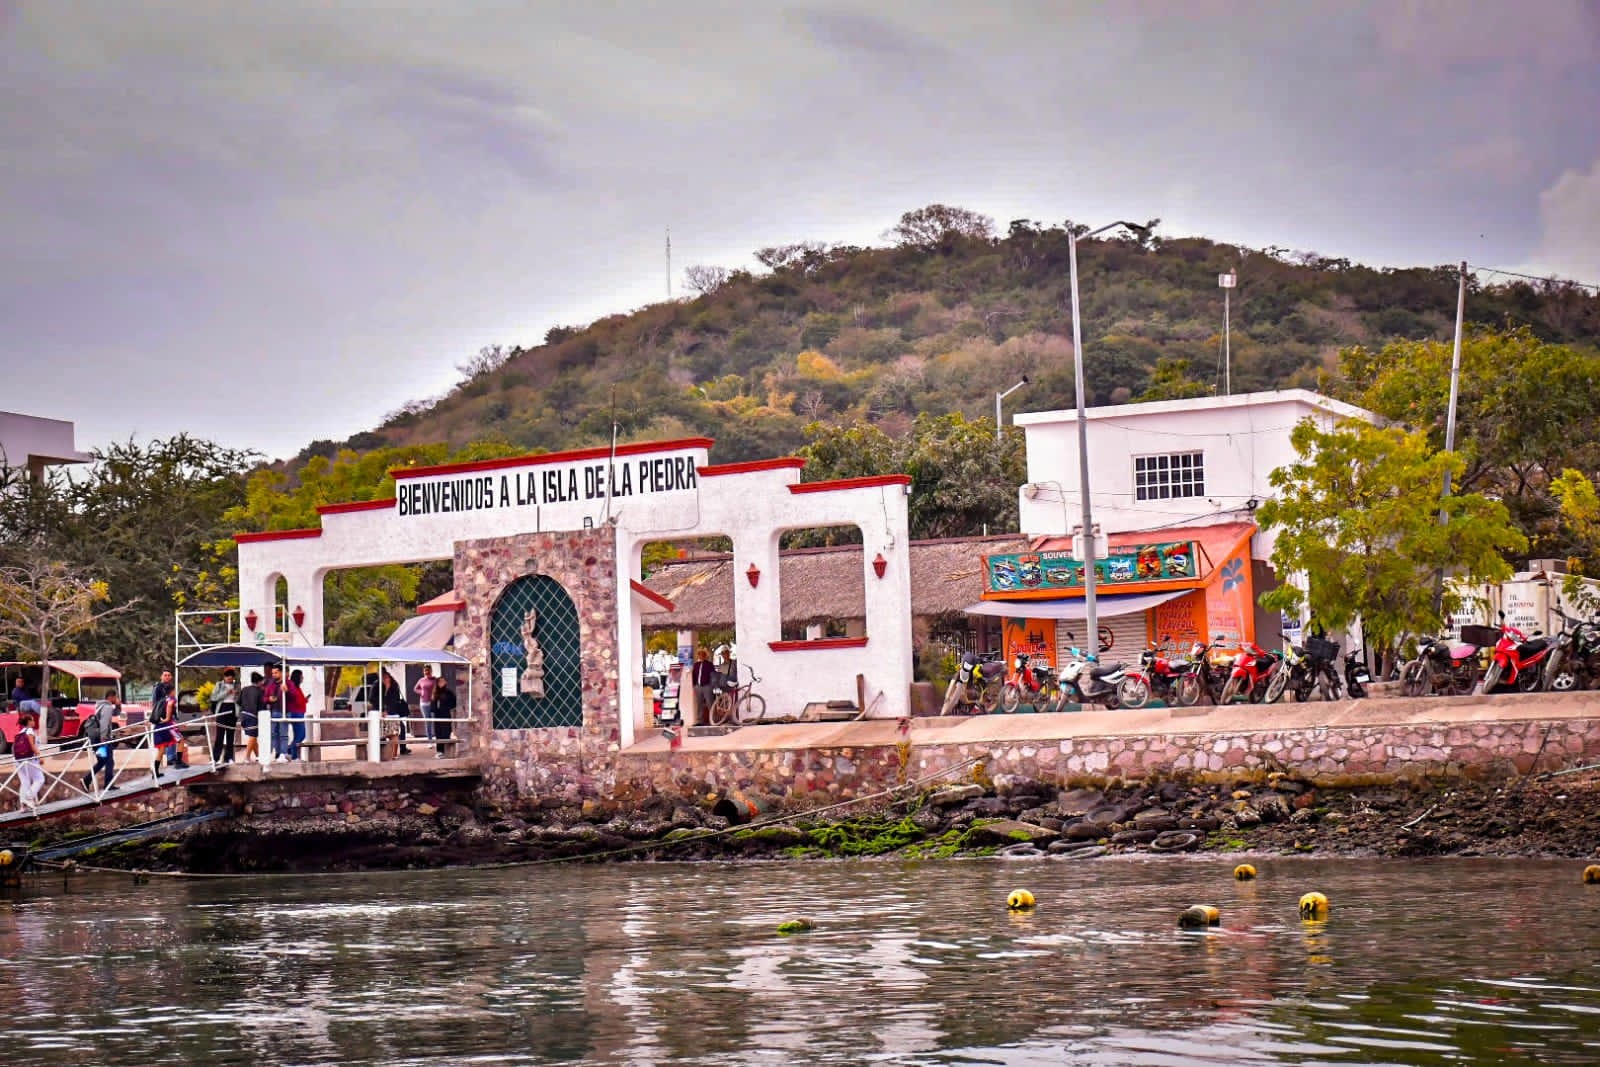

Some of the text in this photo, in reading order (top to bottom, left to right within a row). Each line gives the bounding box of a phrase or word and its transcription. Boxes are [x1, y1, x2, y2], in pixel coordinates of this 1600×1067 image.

[400, 456, 697, 516] BIENVENIDOS A LA ISLA DE LA PIEDRA
